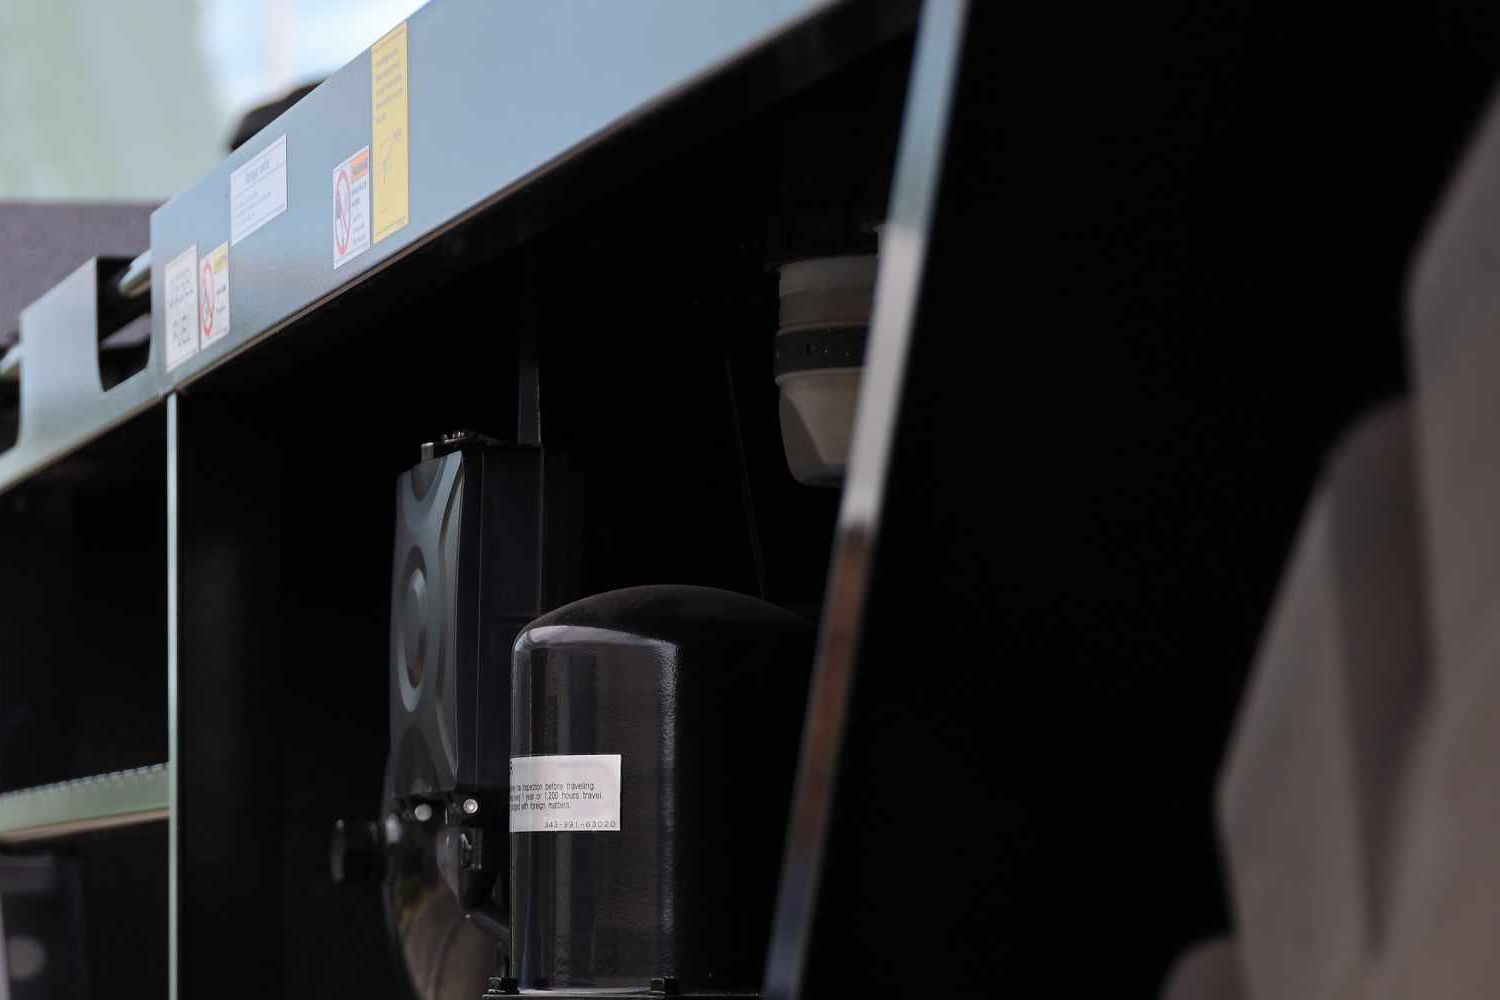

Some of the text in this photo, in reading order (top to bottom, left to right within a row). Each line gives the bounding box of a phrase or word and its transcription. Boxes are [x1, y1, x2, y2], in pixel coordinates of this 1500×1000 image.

[545, 782, 563, 790] before
[566, 782, 596, 791] traveling.
[562, 791, 579, 799] hours
[583, 791, 603, 799] travel.
[530, 802, 545, 811] foreign
[548, 801, 571, 809] matters.
[544, 821, 616, 829] 343-991-63020
